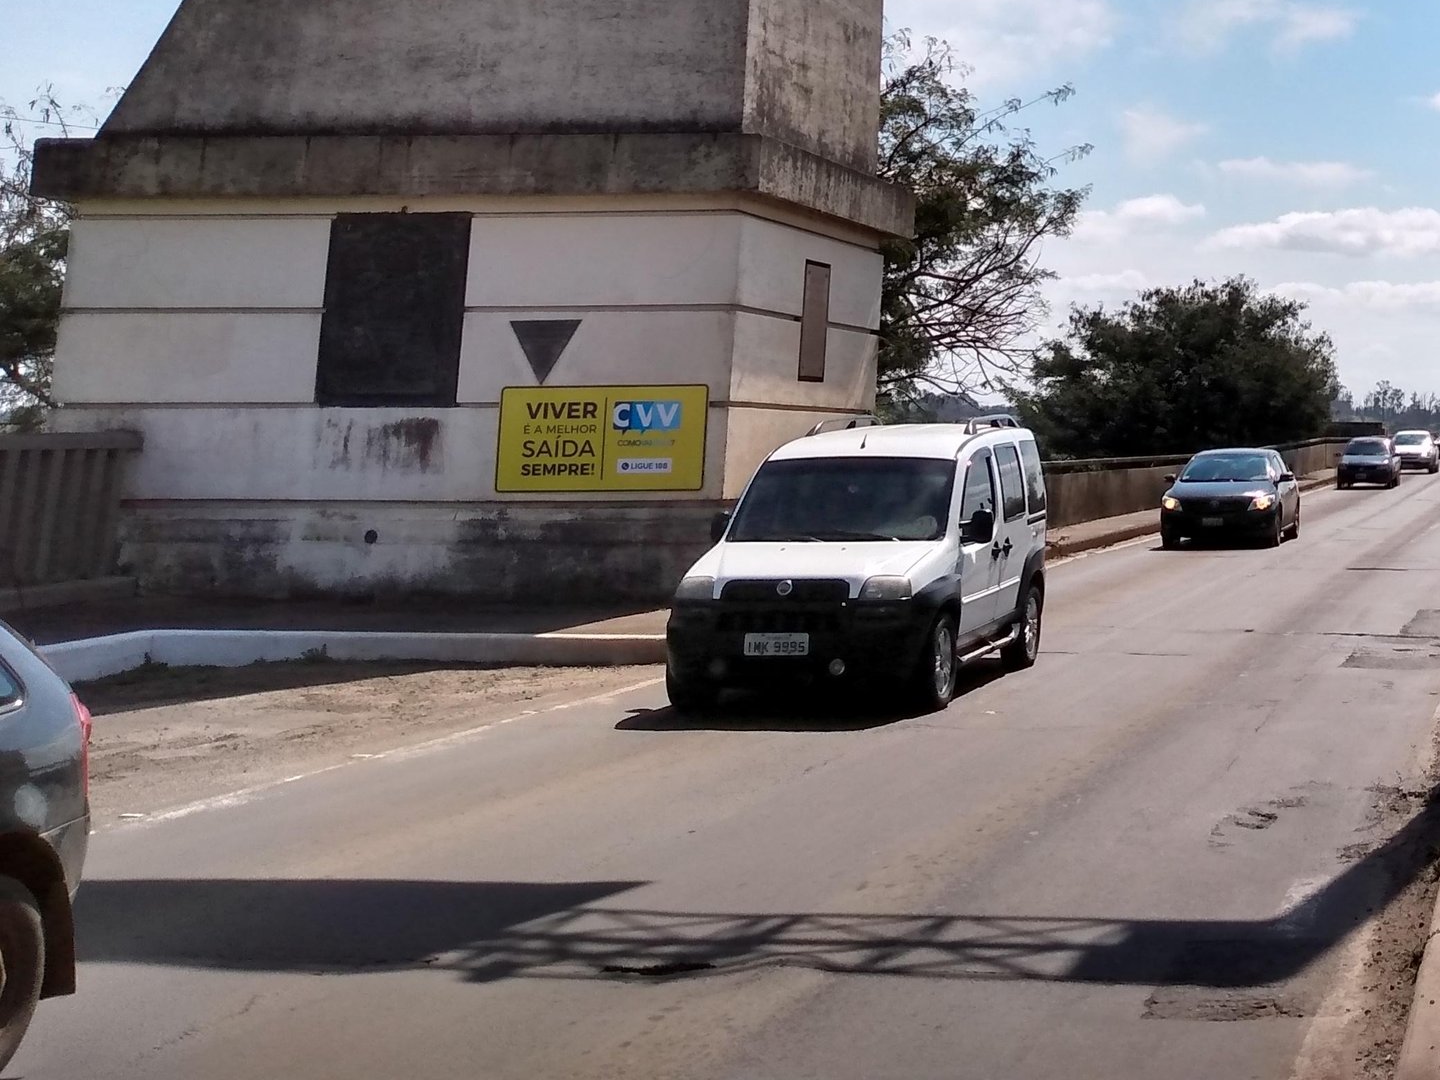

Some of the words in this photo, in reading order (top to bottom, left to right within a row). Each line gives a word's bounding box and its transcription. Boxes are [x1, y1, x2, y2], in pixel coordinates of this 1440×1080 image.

[526, 402, 598, 420] VIVER
[613, 403, 679, 427] CVV
[523, 424, 530, 435] É
[533, 425, 543, 435] A
[547, 424, 597, 435] MELHOR
[522, 435, 596, 458] SAÍDA
[521, 463, 595, 477] SEMPRE!
[630, 462, 654, 470] LIGUE
[655, 462, 668, 470] 188
